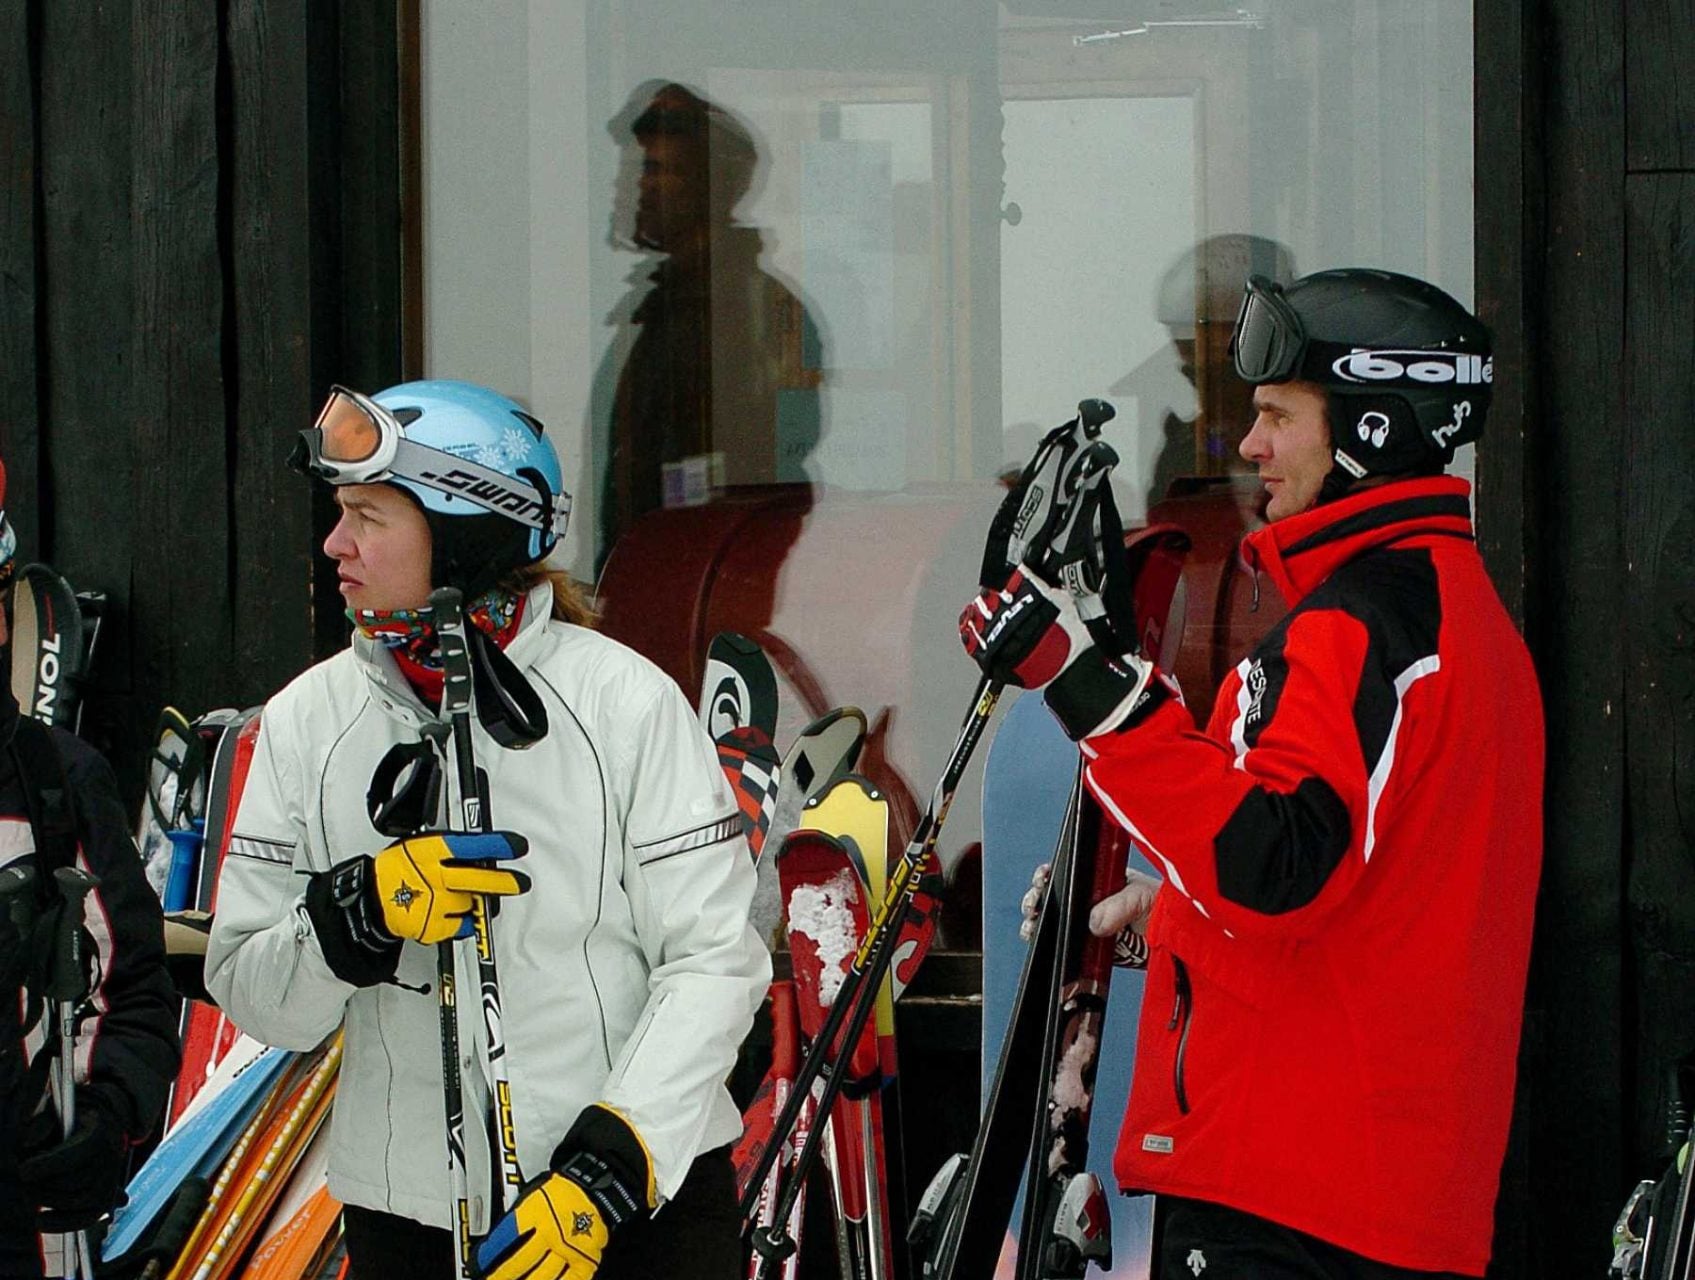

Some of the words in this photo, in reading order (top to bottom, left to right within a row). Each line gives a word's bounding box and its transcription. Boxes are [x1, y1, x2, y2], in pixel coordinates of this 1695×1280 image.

[420, 469, 549, 523] SWAN
[986, 594, 1034, 644] LEVEL
[472, 893, 490, 962] OTT
